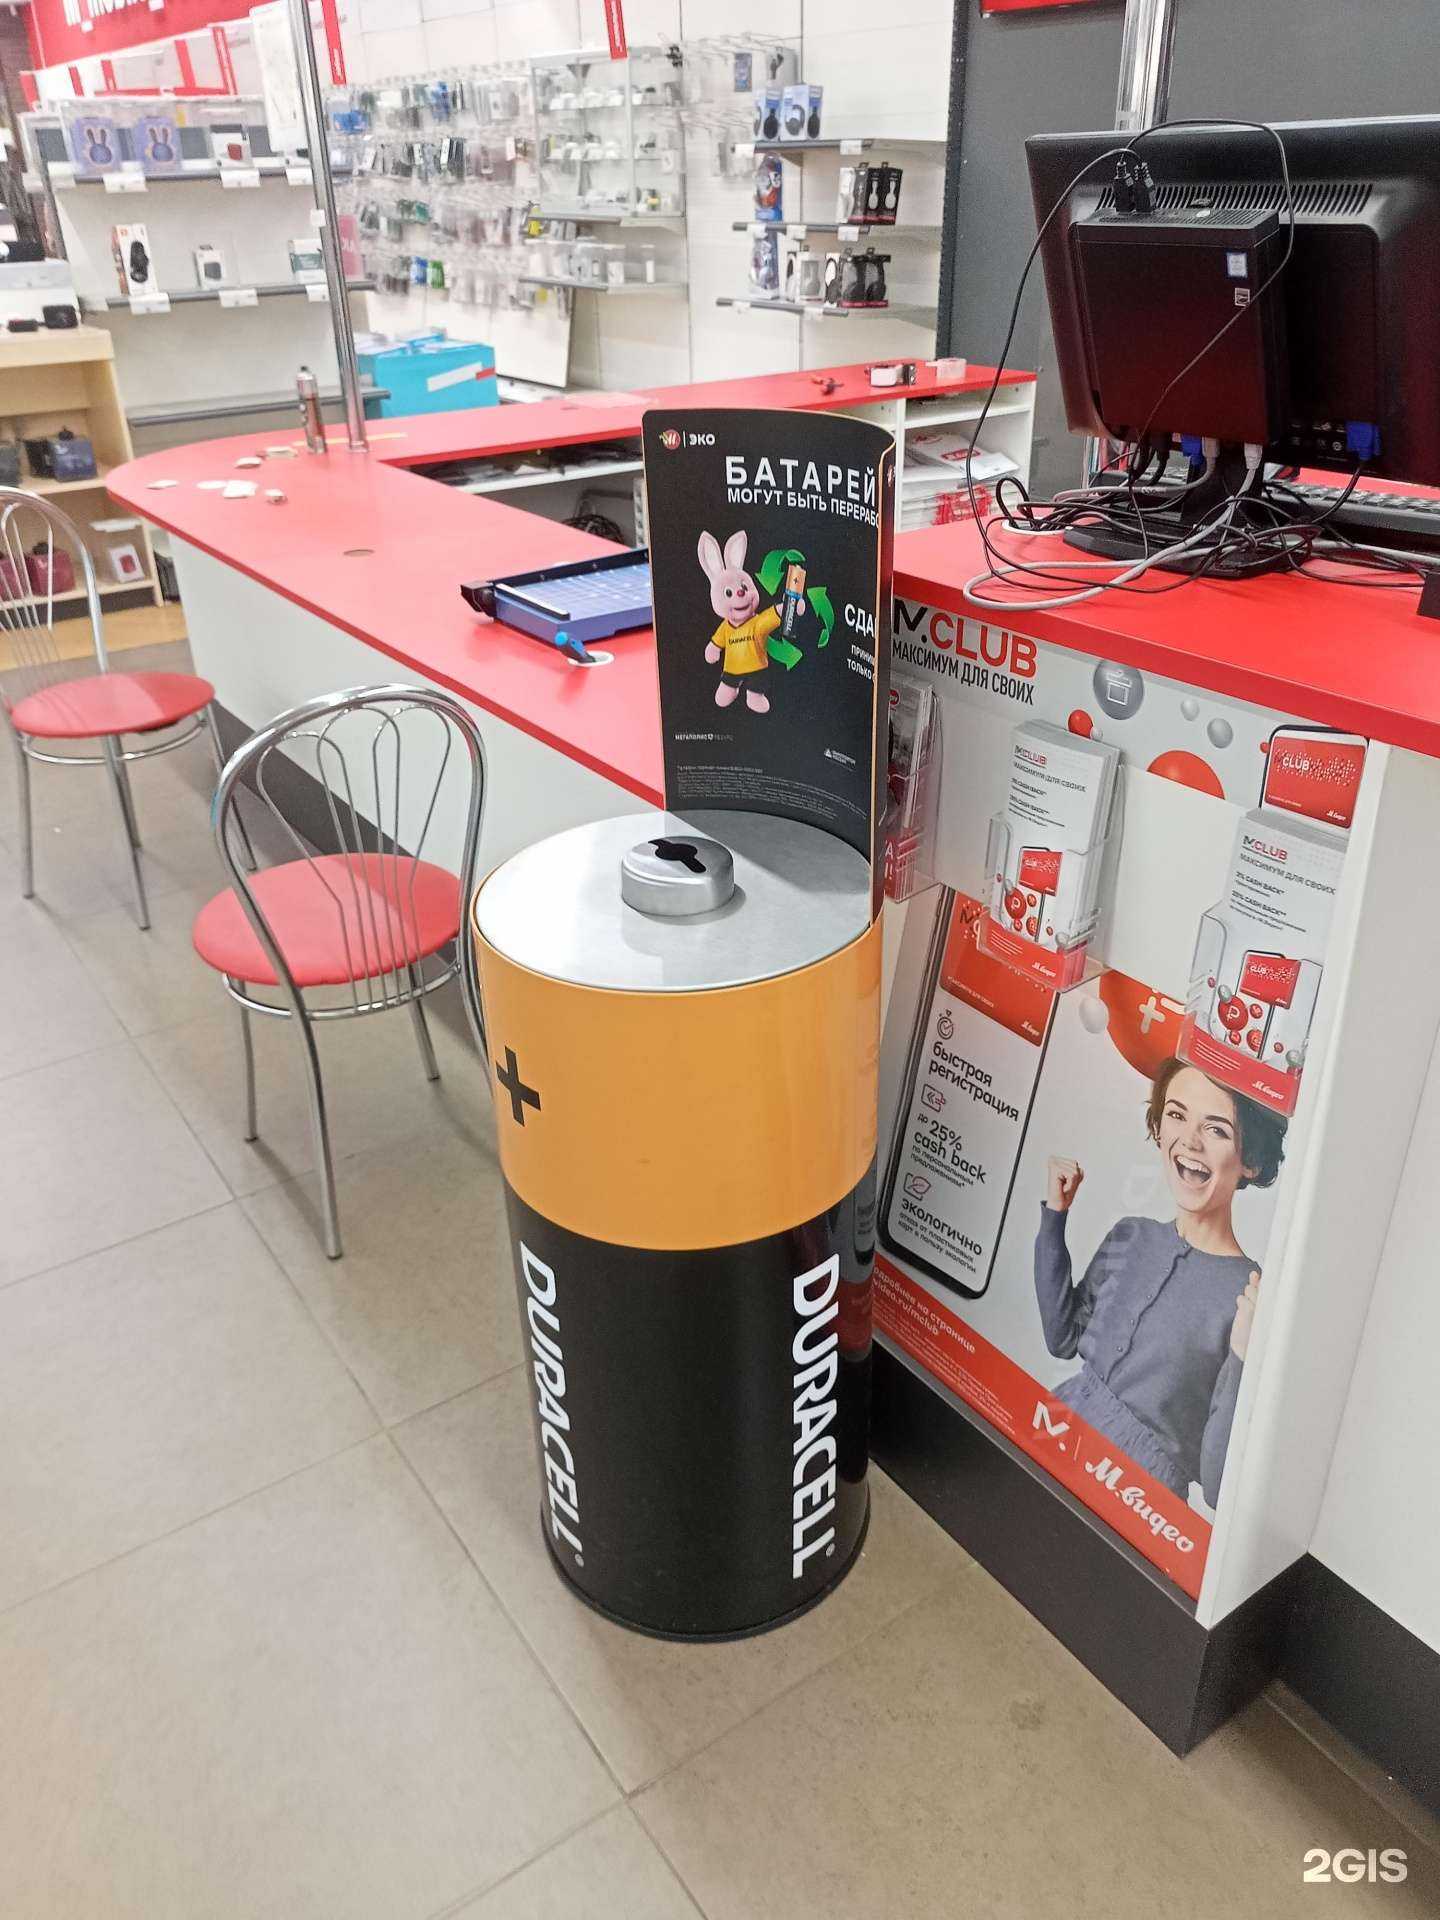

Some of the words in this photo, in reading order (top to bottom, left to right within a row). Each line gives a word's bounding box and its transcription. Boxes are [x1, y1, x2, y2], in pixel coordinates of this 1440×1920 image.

[689, 433, 716, 446] ЭКО
[727, 487, 783, 506] МОГУТ
[787, 492, 827, 512] БЫТЬ
[844, 603, 877, 638] СДА
[892, 639, 959, 680] МАКСИМУМ
[961, 662, 989, 690] ДЛЯ
[991, 672, 1036, 706] СВОИХ
[1305, 879, 1337, 896] СВОИХ
[933, 1040, 993, 1088] быстрая
[928, 1058, 1020, 1122] регистрация
[929, 1119, 963, 1151] 25%
[914, 1131, 947, 1160] cash
[950, 1148, 987, 1184] back
[916, 1301, 930, 1316] на
[519, 1240, 584, 1558] DURACELL
[792, 1253, 840, 1580] DURACELL
